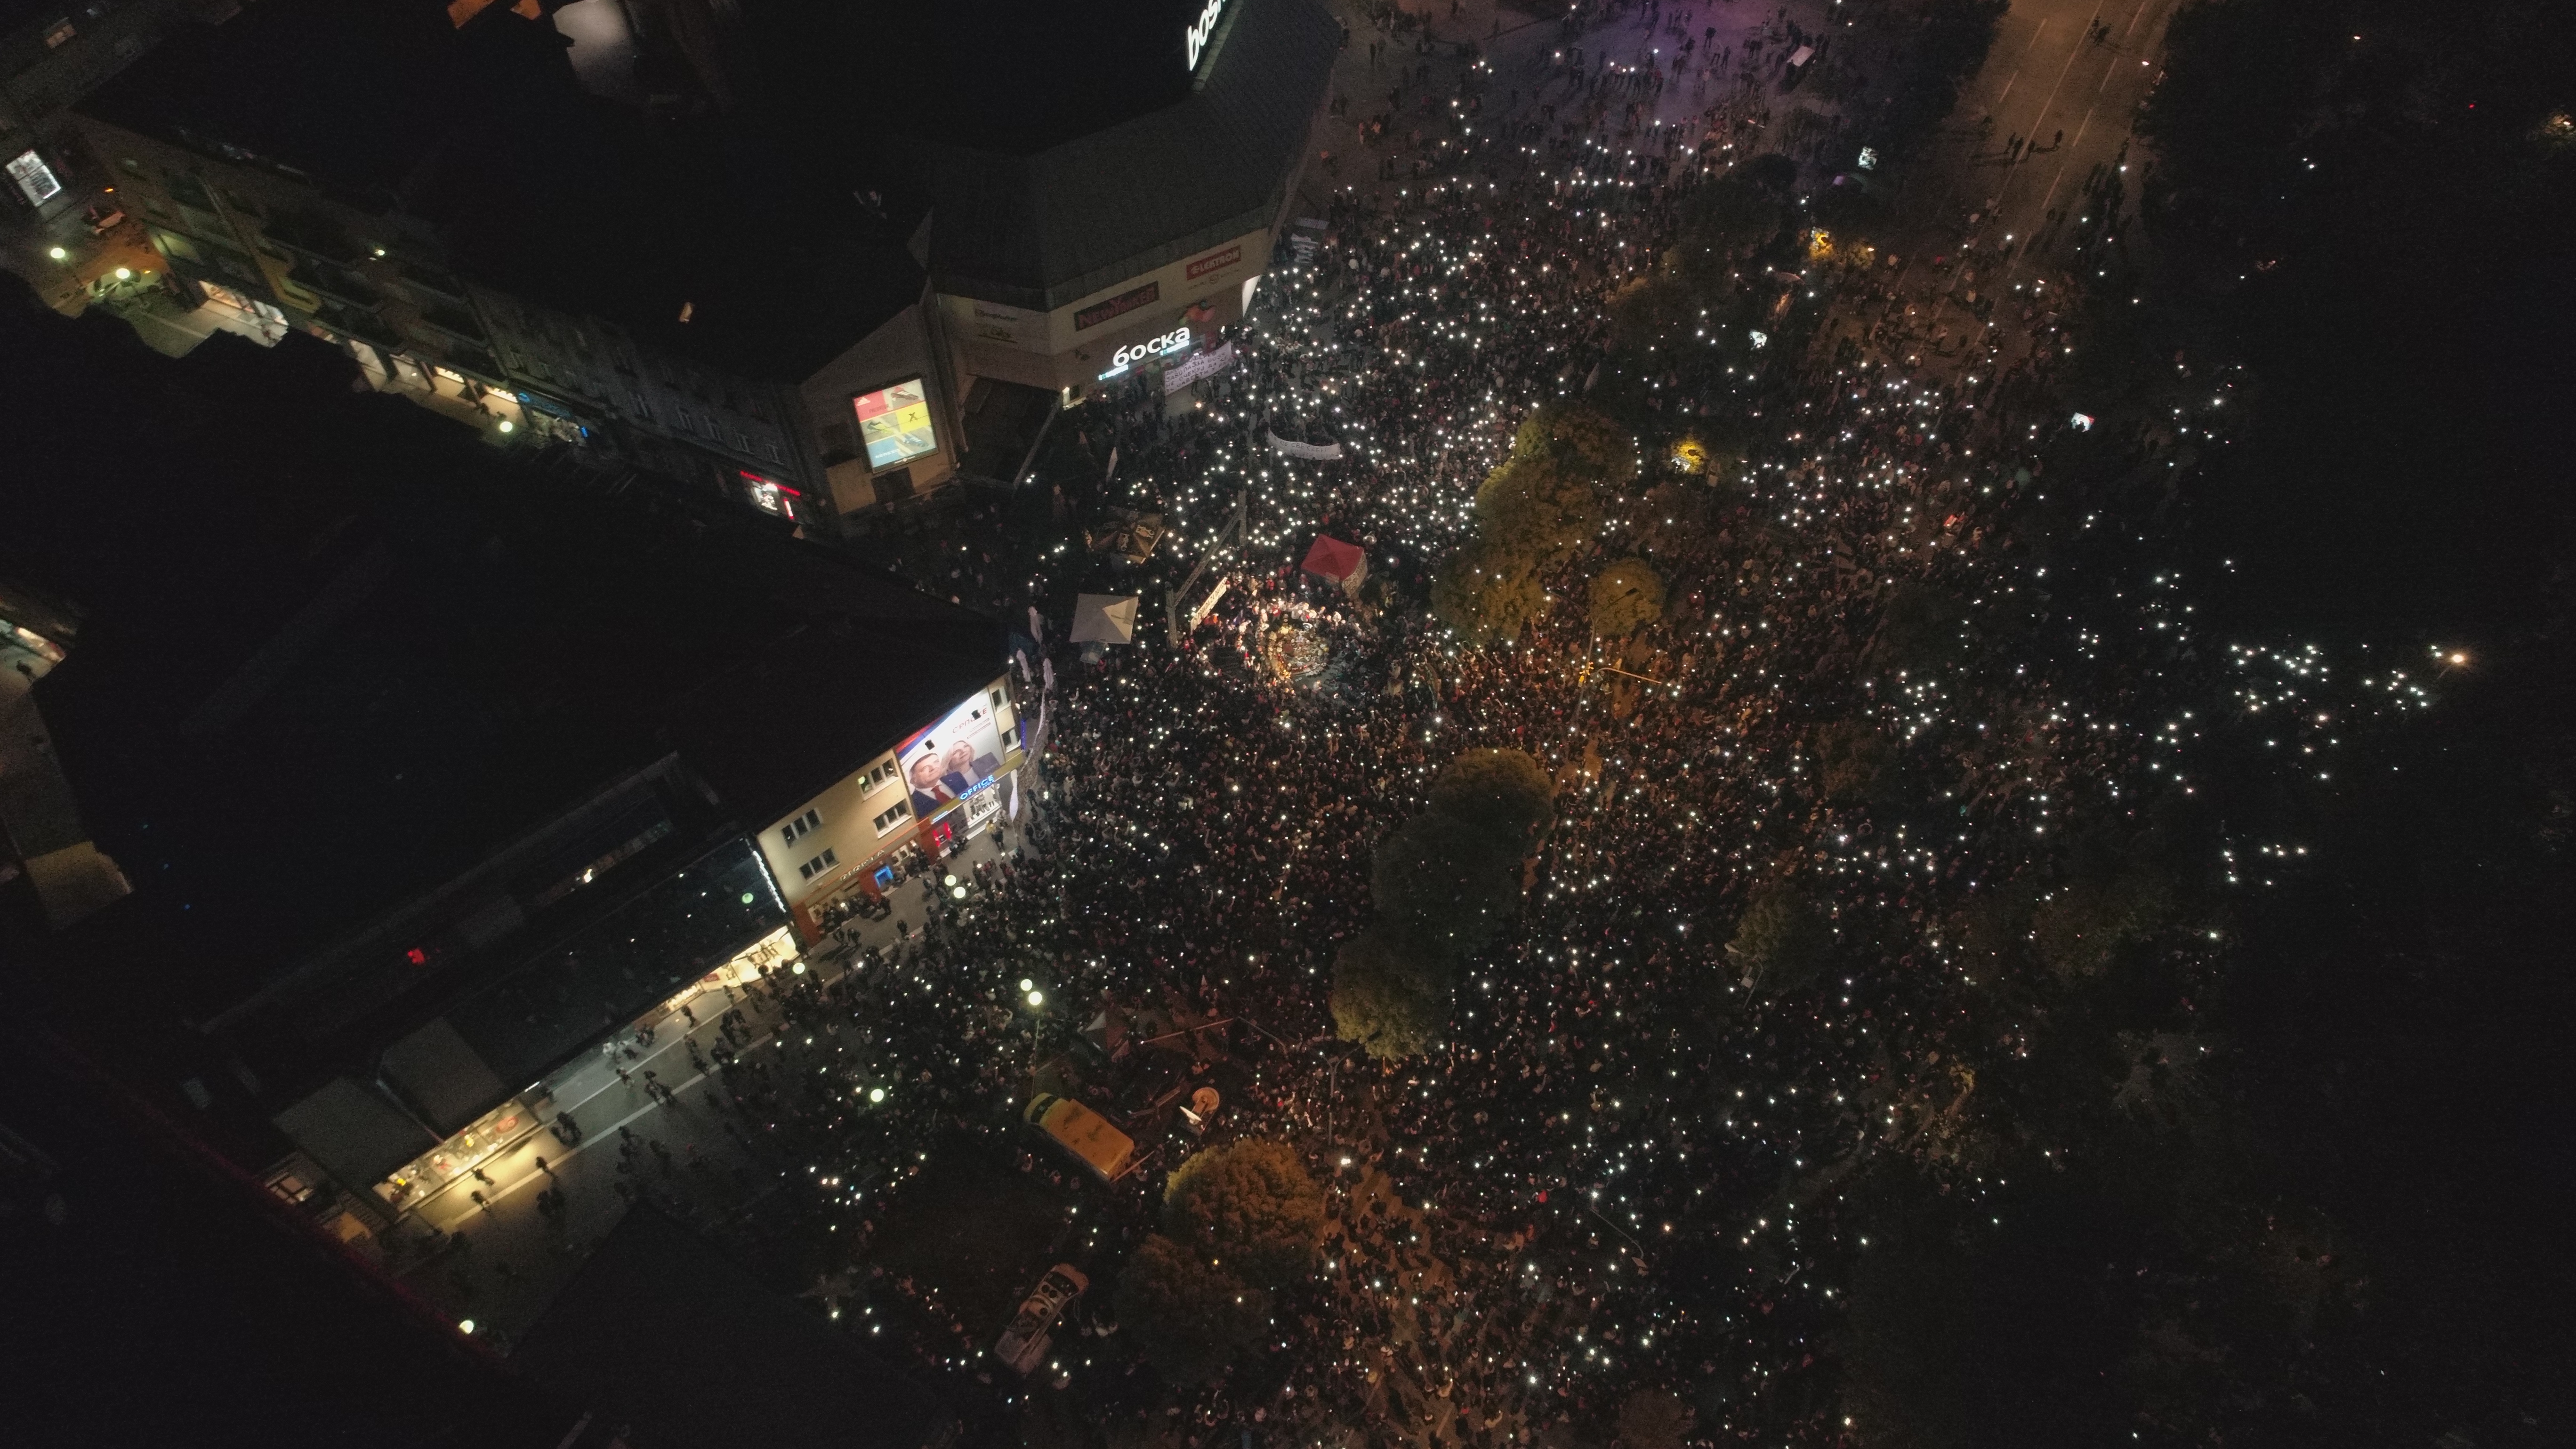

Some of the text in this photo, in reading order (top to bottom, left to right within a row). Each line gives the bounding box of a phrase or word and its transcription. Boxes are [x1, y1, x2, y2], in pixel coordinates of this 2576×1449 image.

[1187, 0, 1225, 72] bos
[1113, 327, 1191, 367] боска
[960, 774, 994, 800] OFFICE
